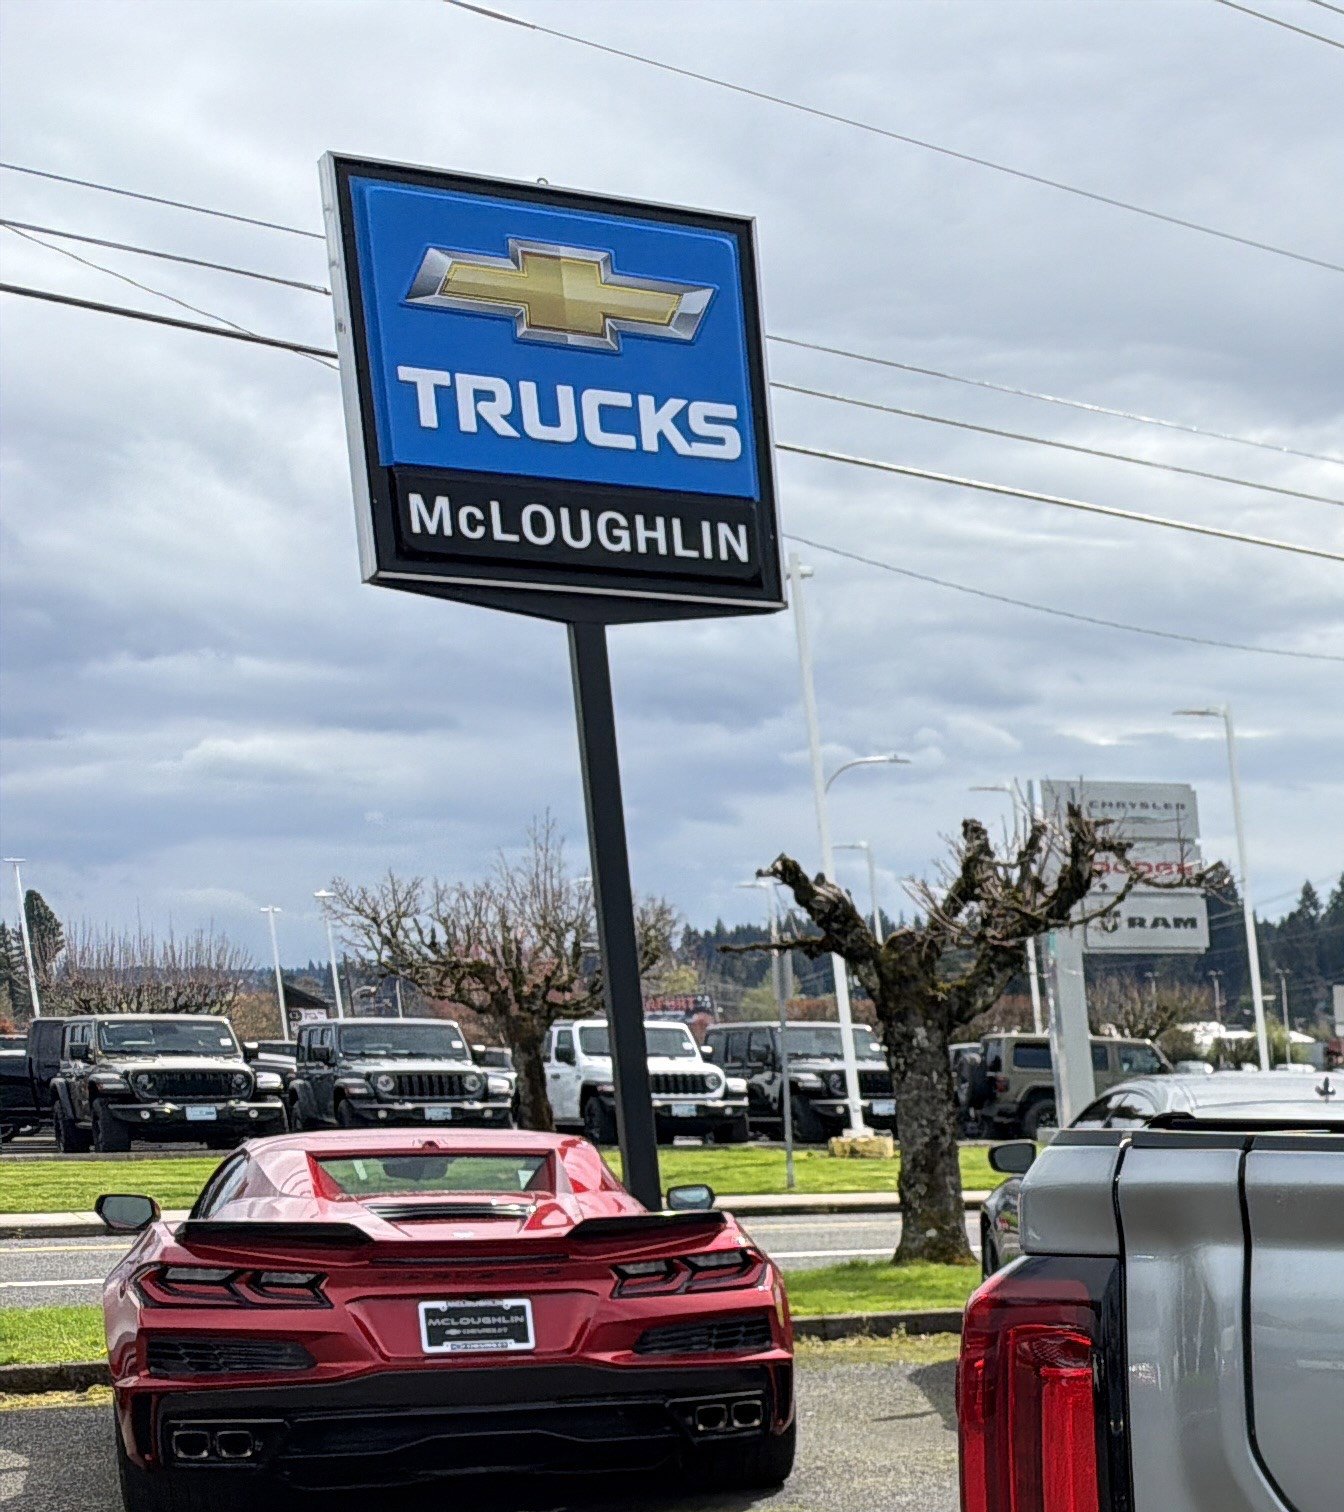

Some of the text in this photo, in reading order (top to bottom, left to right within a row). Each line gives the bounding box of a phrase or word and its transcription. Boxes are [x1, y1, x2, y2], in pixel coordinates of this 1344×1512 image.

[397, 365, 742, 461] TRUCKS
[408, 493, 749, 563] McLOUGHLIN
[1088, 800, 1186, 811] CHRYSLER
[1127, 917, 1198, 929] RAM
[428, 1315, 525, 1327] MCLOUGHLIN
